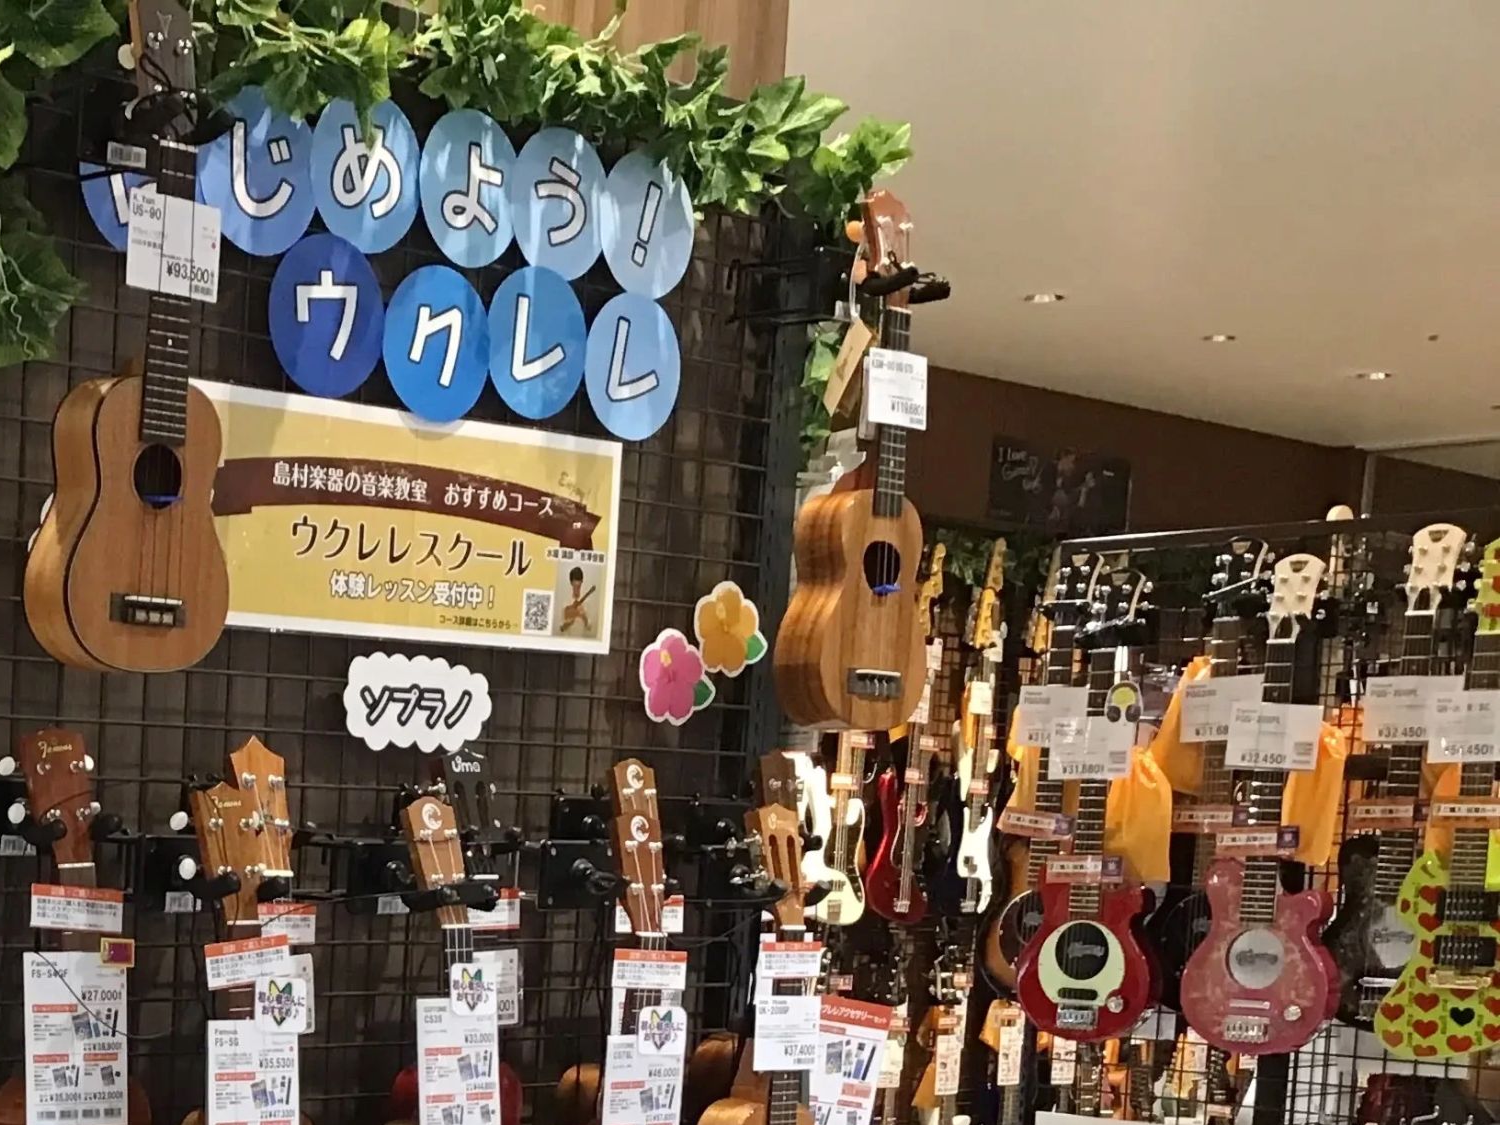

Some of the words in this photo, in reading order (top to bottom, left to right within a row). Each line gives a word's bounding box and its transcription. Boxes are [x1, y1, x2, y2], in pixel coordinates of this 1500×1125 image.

[133, 204, 161, 220] US-90
[296, 269, 659, 401] ウクレレ
[272, 460, 428, 502] 島村楽器の音楽教室
[444, 483, 555, 516] おすすめコース
[291, 515, 531, 576] ウクレレスクール
[330, 570, 495, 609] 体験レッスン受付中!
[360, 684, 473, 729] ソプラノ
